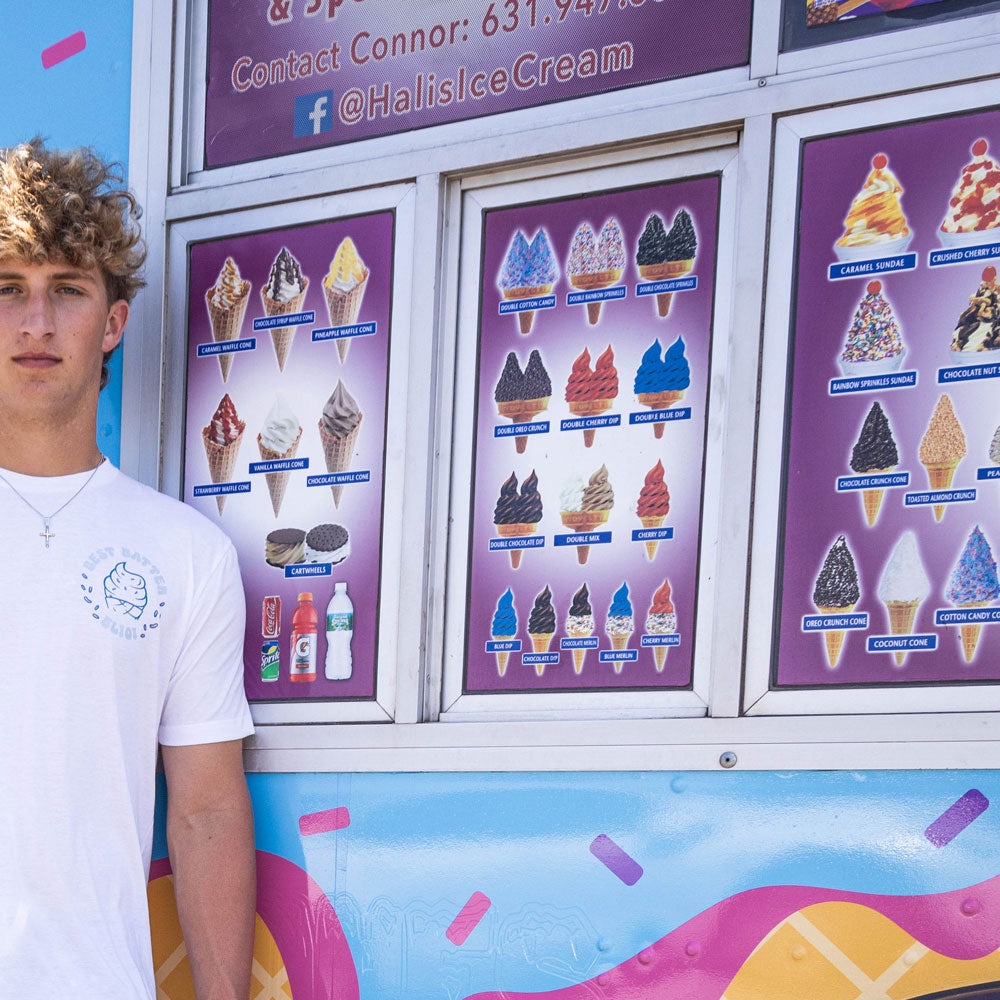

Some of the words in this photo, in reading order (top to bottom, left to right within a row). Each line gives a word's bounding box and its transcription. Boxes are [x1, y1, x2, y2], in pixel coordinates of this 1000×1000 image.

[231, 41, 341, 92] Contact
[350, 18, 470, 66] Connor:
[339, 41, 634, 125] @HalisIceCream
[932, 251, 963, 263] CRUSHED
[964, 247, 991, 258] CHERRY
[840, 262, 874, 275] CARAMEL
[875, 258, 905, 270] SUNDAE
[569, 294, 584, 302] DOUBLE
[501, 303, 518, 311] DOUBLE
[520, 301, 537, 309] COTTON
[315, 329, 339, 339] PINEAPPLE
[340, 327, 358, 336] WAFFLE
[359, 325, 373, 333] CONE
[202, 346, 222, 354] CARAMEL
[222, 343, 239, 351] WAFFLE
[239, 341, 252, 349] CONE
[943, 368, 982, 379] CHOCOLATE
[983, 366, 997, 375] NUT
[833, 381, 860, 391] RAINBOW
[860, 378, 890, 388] SPRINKLES
[890, 375, 914, 385] SUNDAE
[635, 414, 658, 422] DOUBLE
[528, 424, 548, 432] CRUNCH
[562, 421, 585, 429] DOUBLE
[307, 477, 336, 485] CHOCOLATE
[337, 474, 354, 482] WAFFLE
[840, 479, 870, 488] CHOCOLATE
[870, 477, 891, 485] CRUNCH
[907, 495, 930, 503] TOASTED
[930, 493, 952, 501] ALMOND
[953, 491, 975, 499] CRUNCH
[291, 566, 326, 575] CARTWHEELS
[806, 619, 822, 627] OREO
[823, 618, 848, 627] CRUNCH
[849, 617, 867, 625] CONE
[939, 612, 967, 621] COTTON
[968, 612, 991, 620] CANDY
[874, 640, 907, 648] COCONUT
[909, 638, 928, 647] CONE
